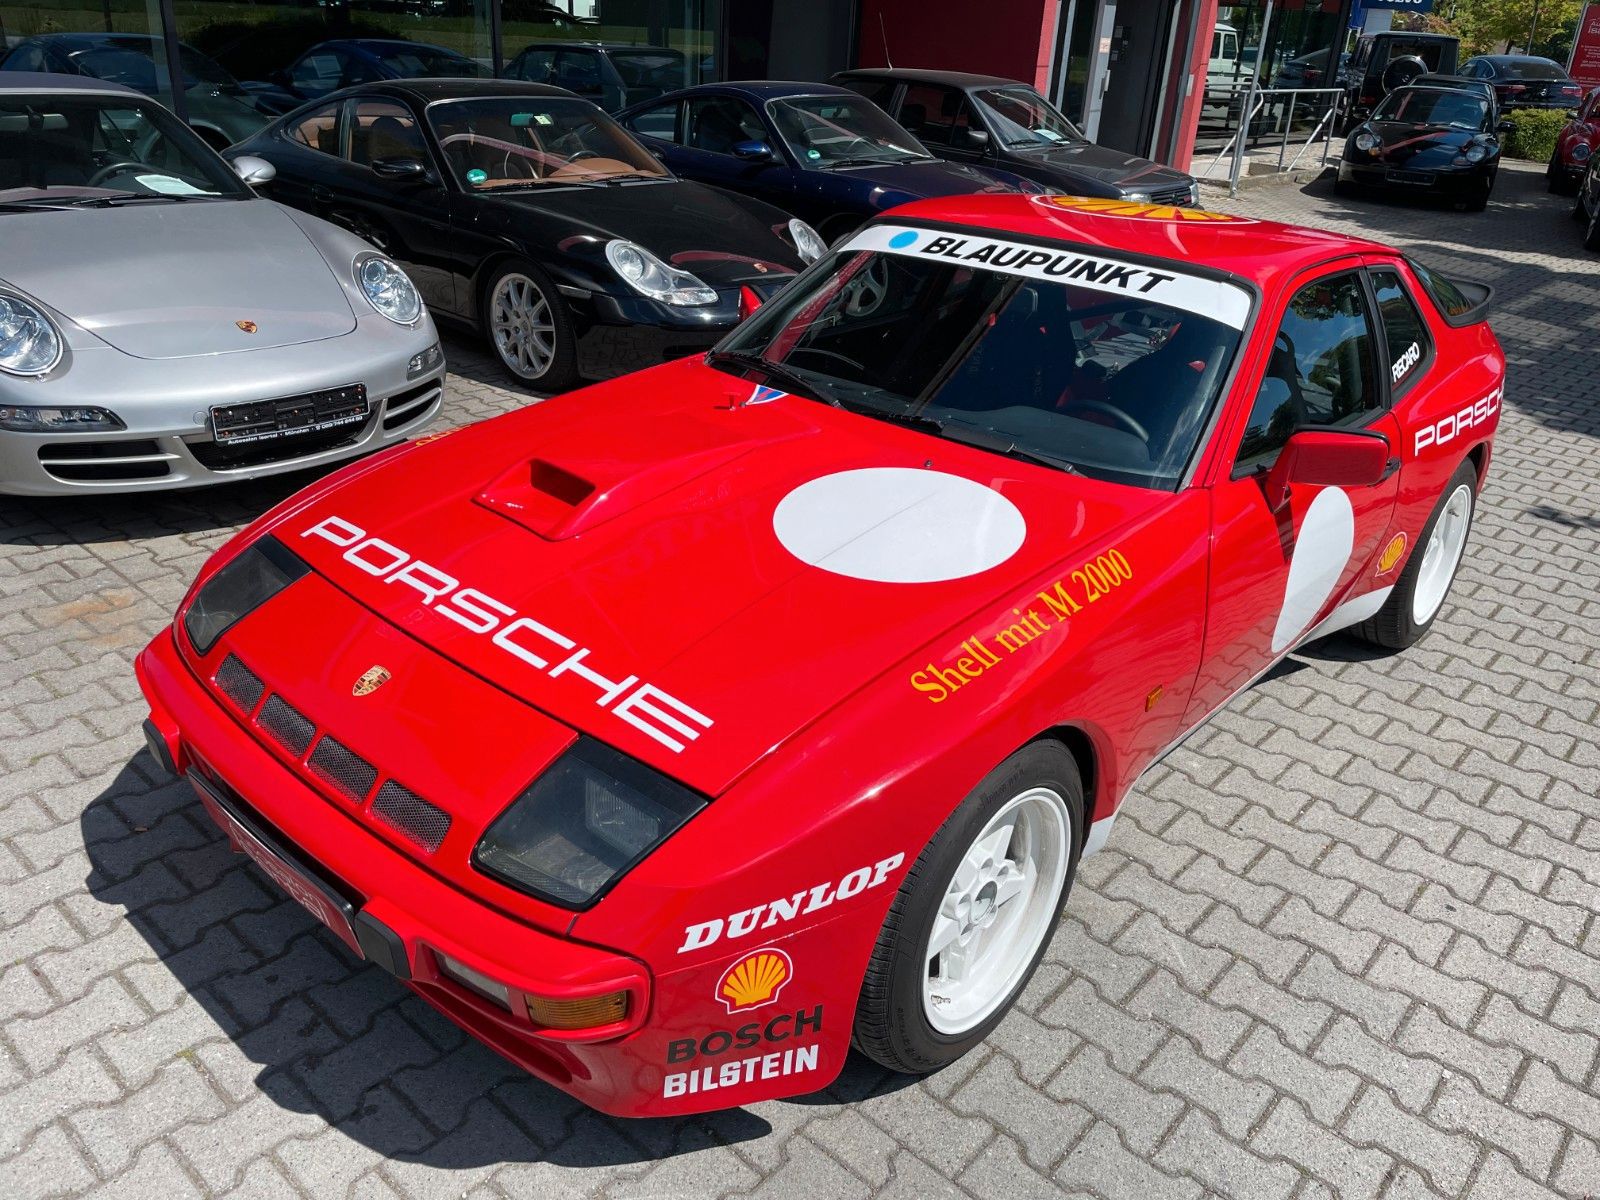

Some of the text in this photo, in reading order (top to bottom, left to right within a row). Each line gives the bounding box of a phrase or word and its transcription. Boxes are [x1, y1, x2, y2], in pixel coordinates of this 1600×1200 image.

[920, 236, 1177, 294] BLAUPUNKT
[1391, 341, 1420, 382] RECARO
[1414, 374, 1505, 457] PORSCH
[300, 515, 715, 754] PORSCHE
[910, 548, 1133, 703] Shell mit M 2000
[677, 852, 905, 954] DUNLOP
[666, 1005, 823, 1064] BOSCH
[663, 1044, 819, 1099] BILSTEIN
